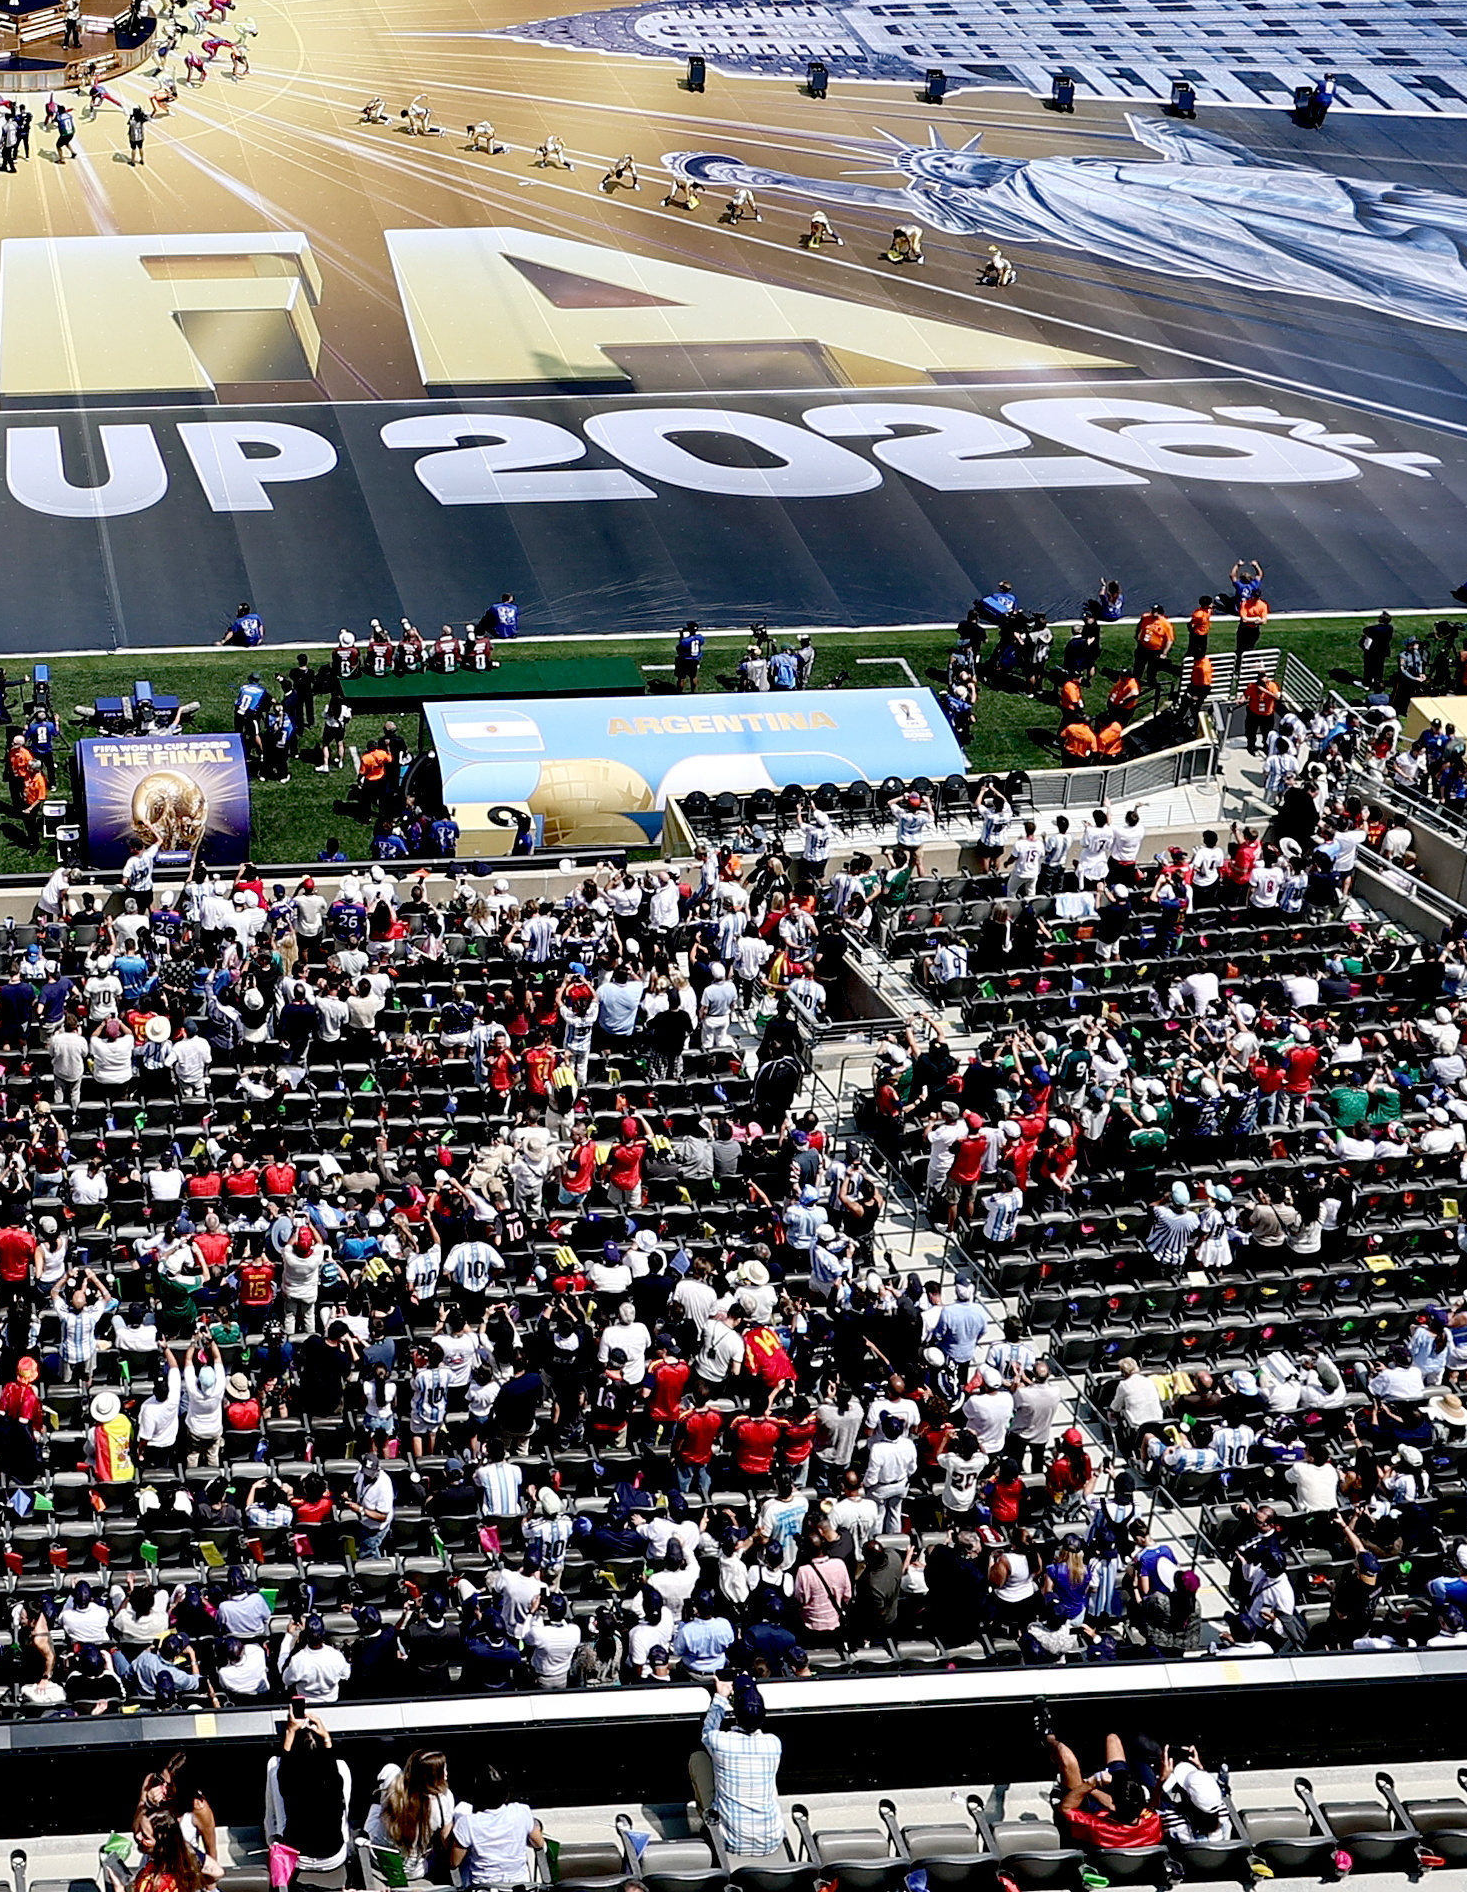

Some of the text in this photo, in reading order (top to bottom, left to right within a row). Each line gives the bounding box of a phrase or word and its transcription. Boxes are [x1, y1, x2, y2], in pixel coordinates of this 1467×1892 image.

[381, 398, 1360, 504] 2026
[608, 711, 838, 736] ARGENTINA
[92, 741, 236, 753] FIFA WORLD CUP 2026
[94, 749, 233, 766] THE FINAL
[505, 1222, 523, 1241] 10
